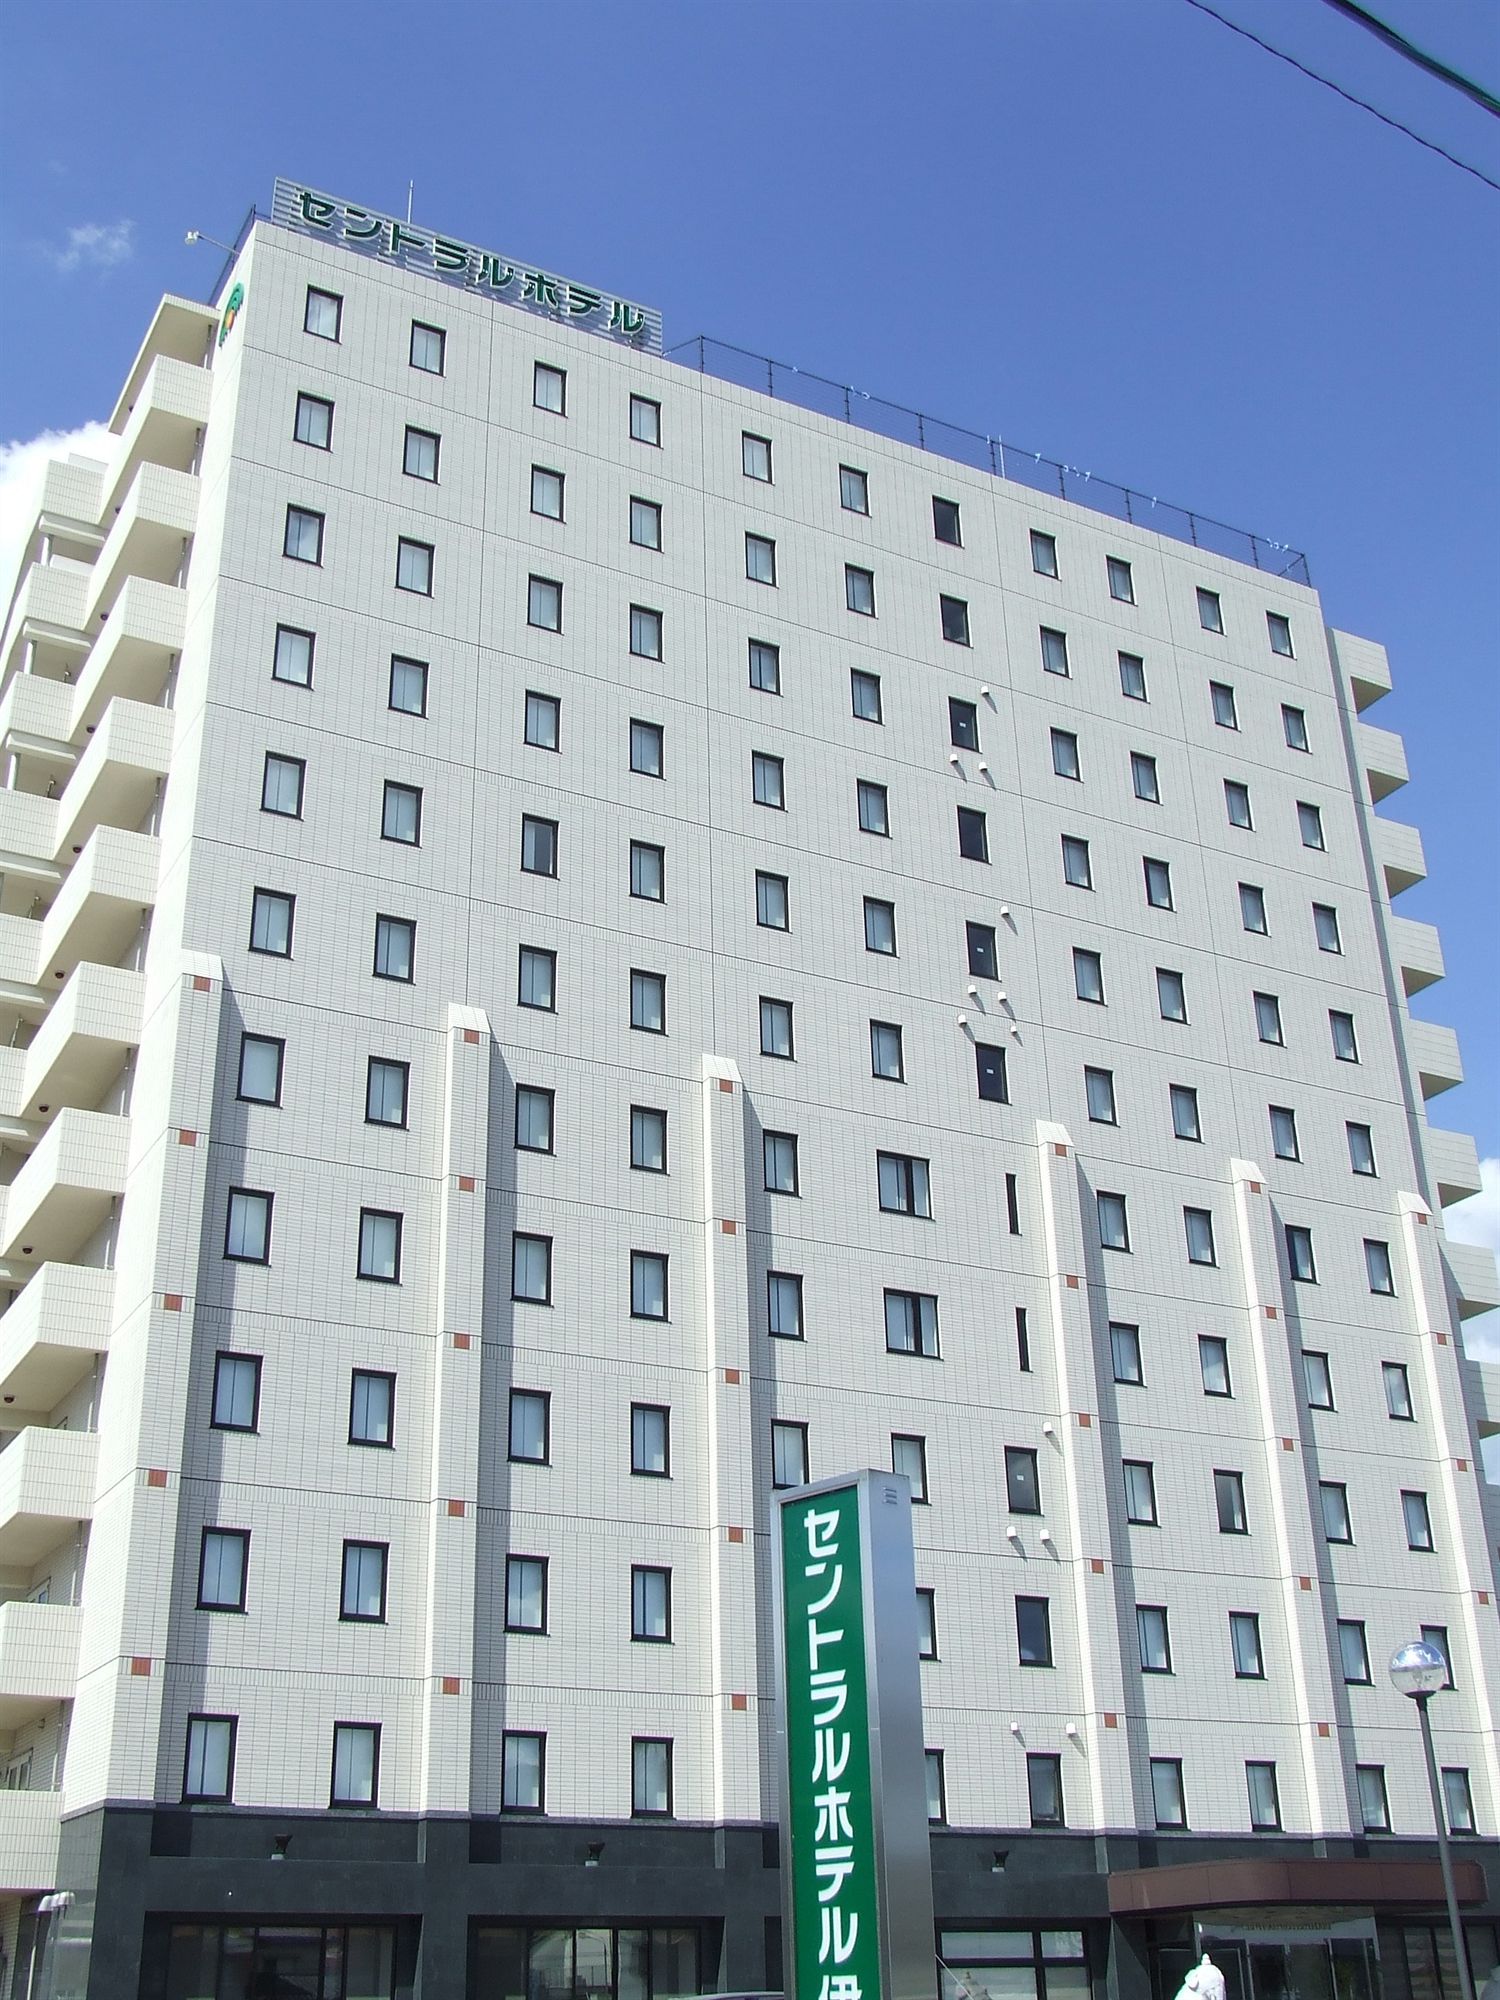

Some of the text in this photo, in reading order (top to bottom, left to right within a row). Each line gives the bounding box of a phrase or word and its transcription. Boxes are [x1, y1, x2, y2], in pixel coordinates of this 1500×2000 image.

[299, 191, 646, 334] セントラルホテル
